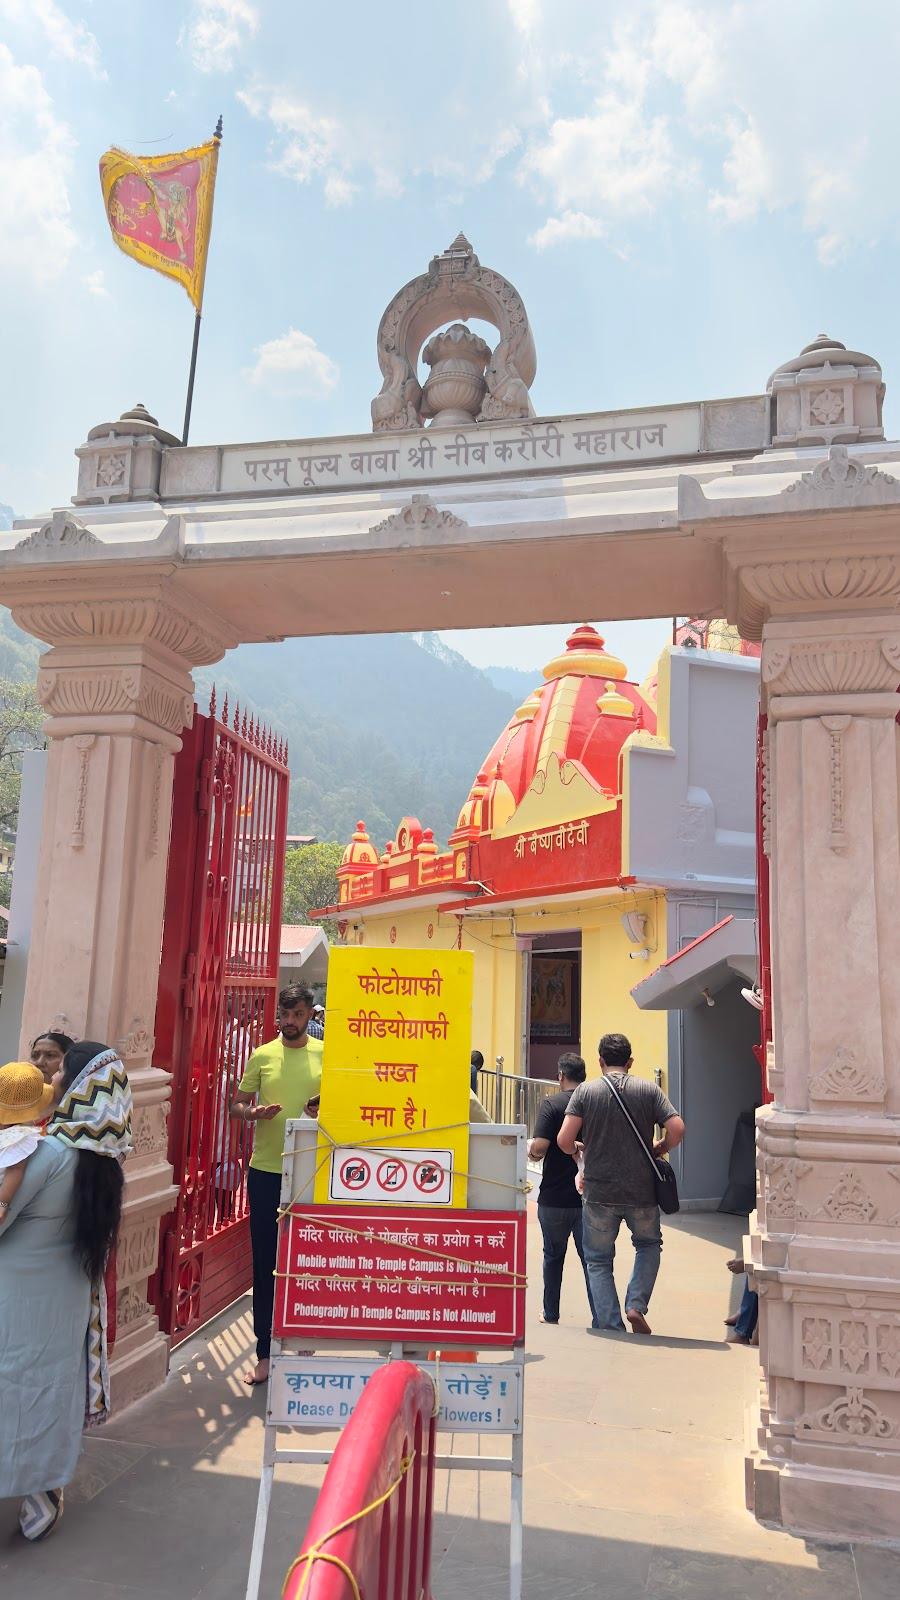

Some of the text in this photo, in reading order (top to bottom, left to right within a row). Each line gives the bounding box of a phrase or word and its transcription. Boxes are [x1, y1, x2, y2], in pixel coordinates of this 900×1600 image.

[244, 423, 668, 486] परम् पूज्य बाबा श्री नीब करौरी महाराज
[513, 834, 527, 859] श्री
[357, 967, 444, 998] फोटोग्राफी
[347, 1009, 449, 1041] वीडियोग्राफी
[373, 1061, 419, 1083] सख्त
[360, 1105, 396, 1128] मना
[298, 1224, 324, 1244] मंदिर
[423, 1232, 439, 1246] का
[442, 1229, 471, 1247] प्रयोग
[474, 1234, 484, 1248] न
[487, 1230, 506, 1249] करें
[297, 1253, 509, 1275] Mobile within The Temple Campus is Not Allowed
[295, 1272, 322, 1292] मंदिर
[325, 1273, 358, 1293] परिसर
[447, 1281, 467, 1297] मना
[293, 1302, 496, 1324] Photography in Temple Campus is Not Allowed
[284, 1373, 355, 1394] कृपया
[445, 1373, 493, 1401] तोड़ें
[287, 1400, 334, 1416] Please
